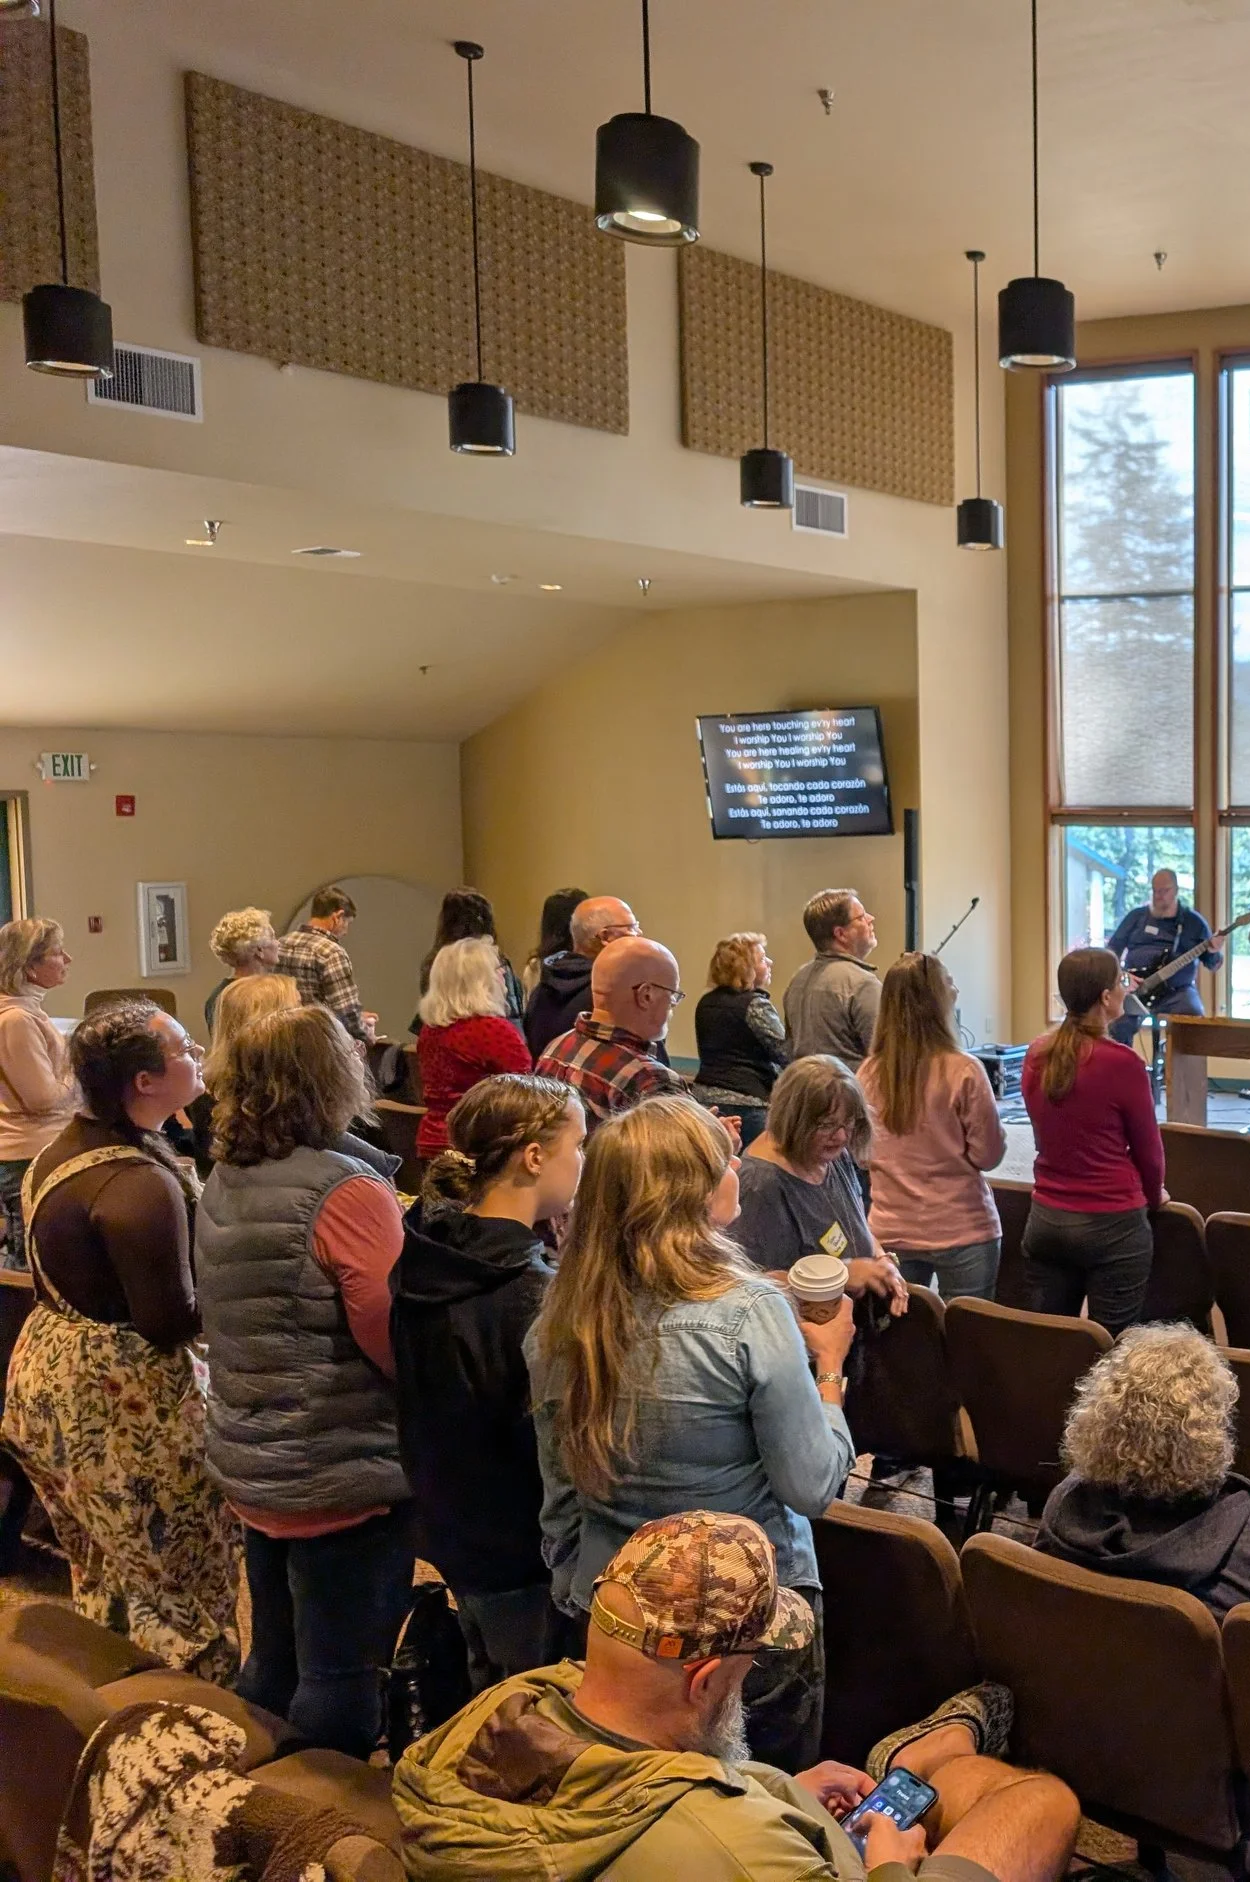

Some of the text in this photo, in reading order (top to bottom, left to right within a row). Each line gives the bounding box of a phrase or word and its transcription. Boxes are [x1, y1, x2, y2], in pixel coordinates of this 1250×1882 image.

[719, 724, 736, 733] You
[737, 723, 750, 732] are
[752, 722, 771, 731] here
[773, 719, 809, 731] touching
[832, 717, 855, 726] heart
[739, 734, 770, 745] worship
[771, 734, 788, 743] You
[792, 731, 824, 742] worship
[826, 732, 842, 740] You
[725, 749, 741, 758] You
[743, 748, 757, 757] are
[758, 747, 777, 756] here
[779, 745, 809, 756] healing
[832, 743, 855, 752] heart
[52, 754, 82, 776] EXIT
[741, 760, 773, 770] worship
[774, 759, 791, 769] You
[796, 757, 828, 768] worship
[830, 757, 846, 766] You
[725, 783, 746, 793] Estás
[769, 782, 805, 792] tocando
[807, 780, 830, 790] cada
[831, 778, 866, 789] corazón
[759, 795, 767, 804] Te
[798, 794, 807, 803] te
[809, 793, 835, 802] adoro
[728, 807, 749, 818] Estás
[772, 806, 808, 816] sanando
[810, 805, 833, 815] cada
[834, 803, 869, 814] corazón
[761, 819, 771, 829] Te
[801, 819, 811, 828] te
[812, 818, 838, 828] adoro
